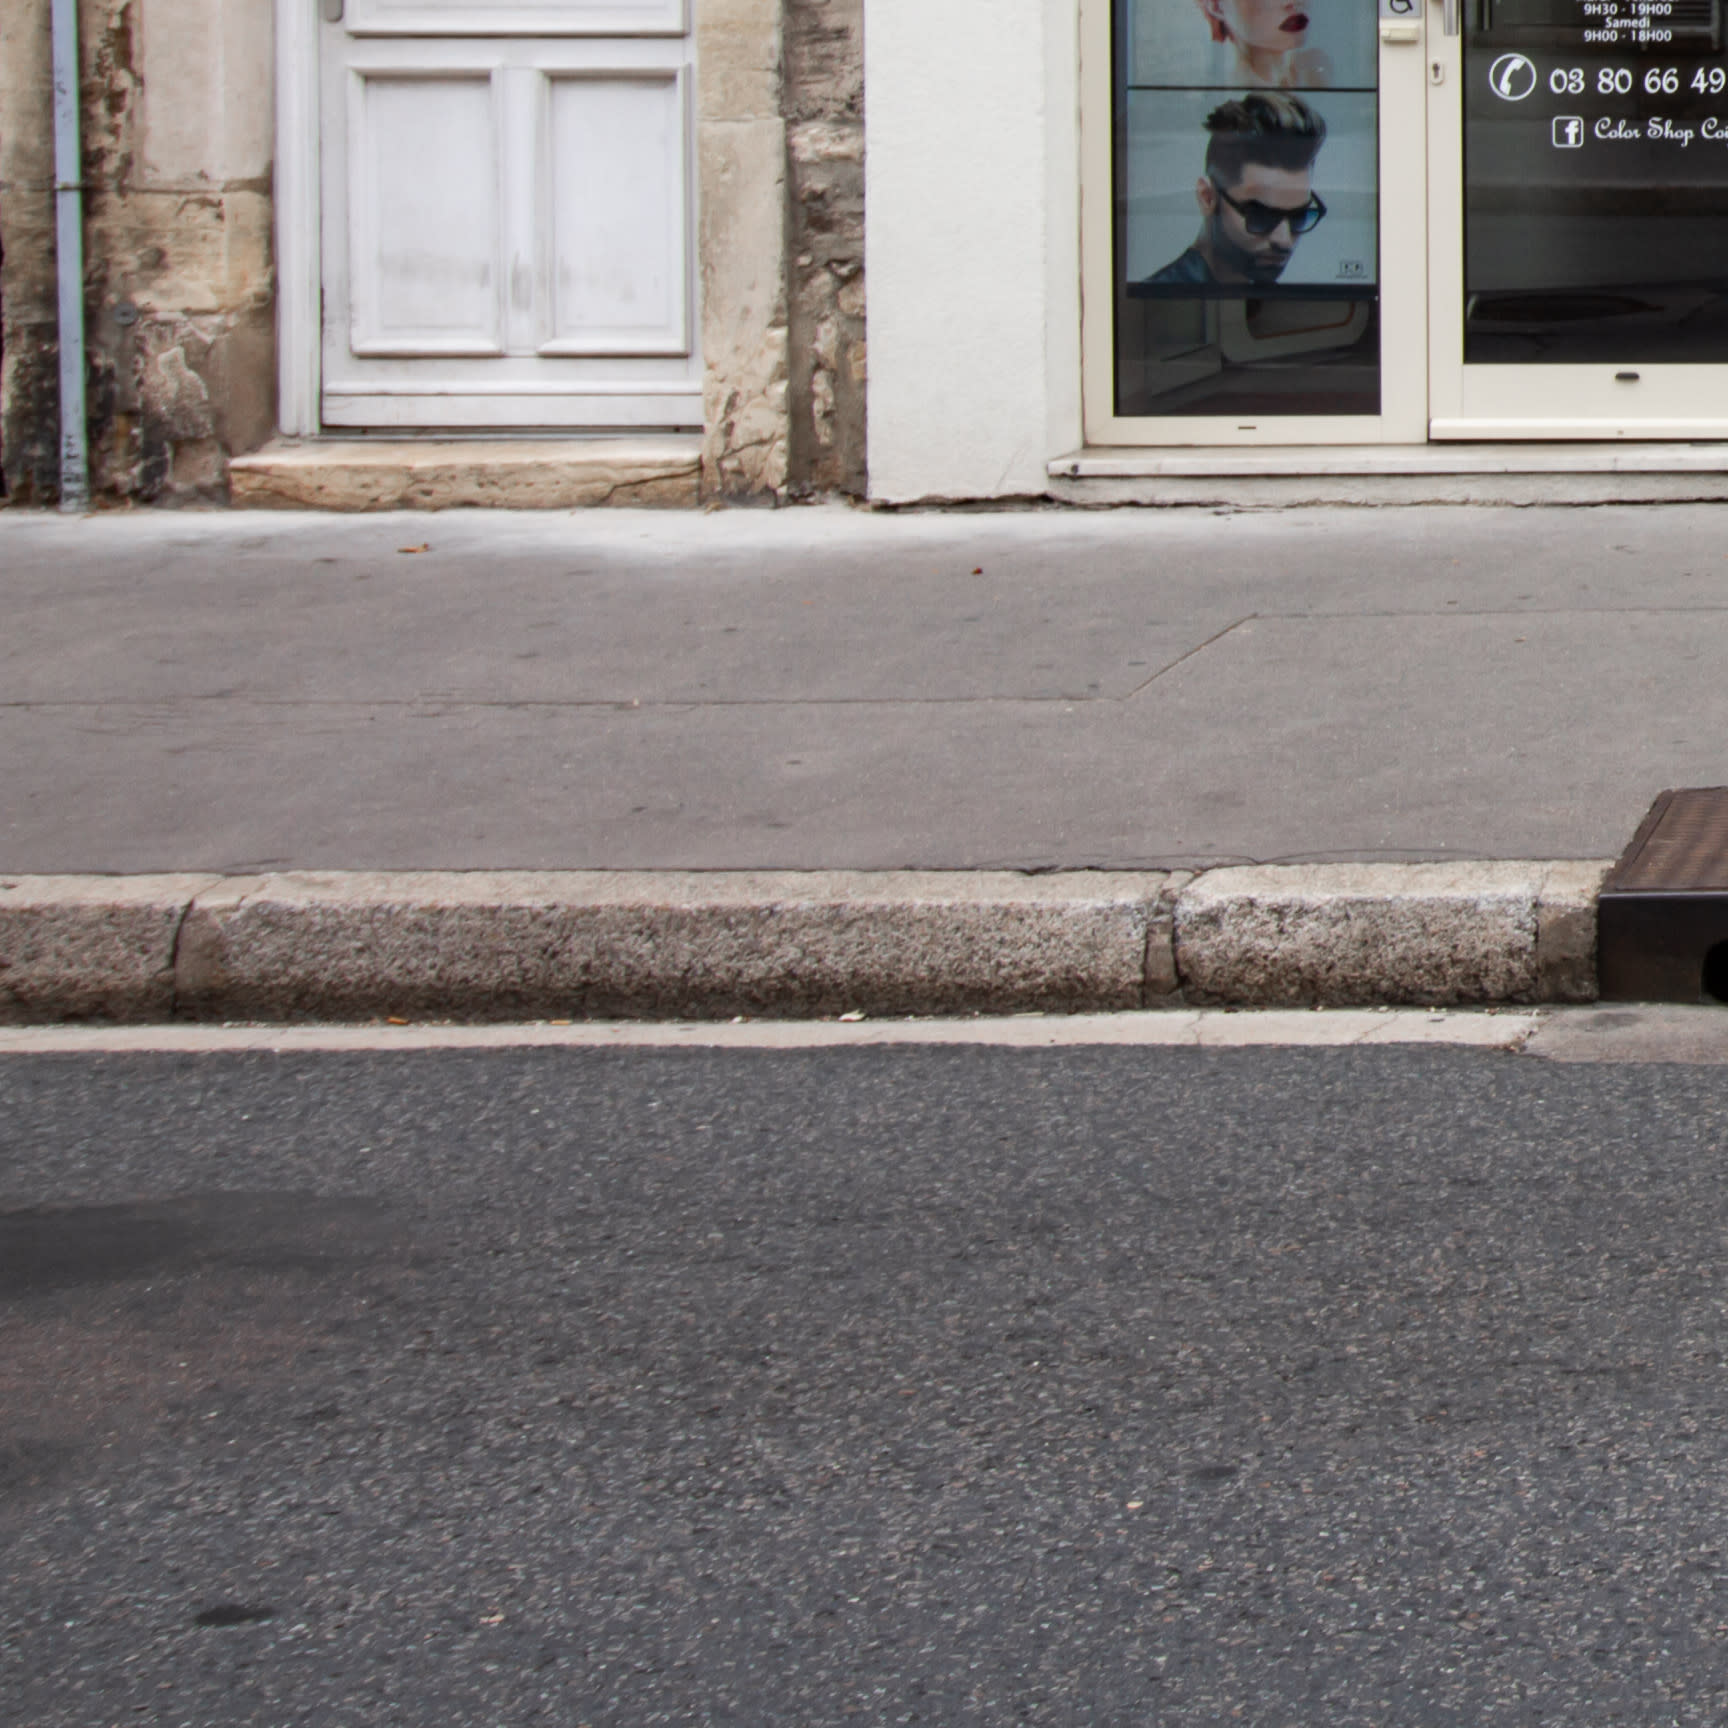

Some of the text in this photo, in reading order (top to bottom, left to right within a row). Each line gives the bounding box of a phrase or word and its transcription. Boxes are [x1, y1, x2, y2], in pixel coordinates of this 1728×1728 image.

[1584, 3, 1618, 16] 9H30
[1630, 3, 1672, 16] 19H00
[1605, 16, 1650, 29] Samedi
[1584, 29, 1618, 42] 9H00
[1630, 29, 1672, 42] 18H00
[1550, 67, 1585, 95] 03
[1597, 67, 1633, 95] 80
[1644, 67, 1679, 95] 66
[1691, 67, 1726, 95] 49
[1594, 117, 1641, 140] Color
[1647, 117, 1694, 147] Shop
